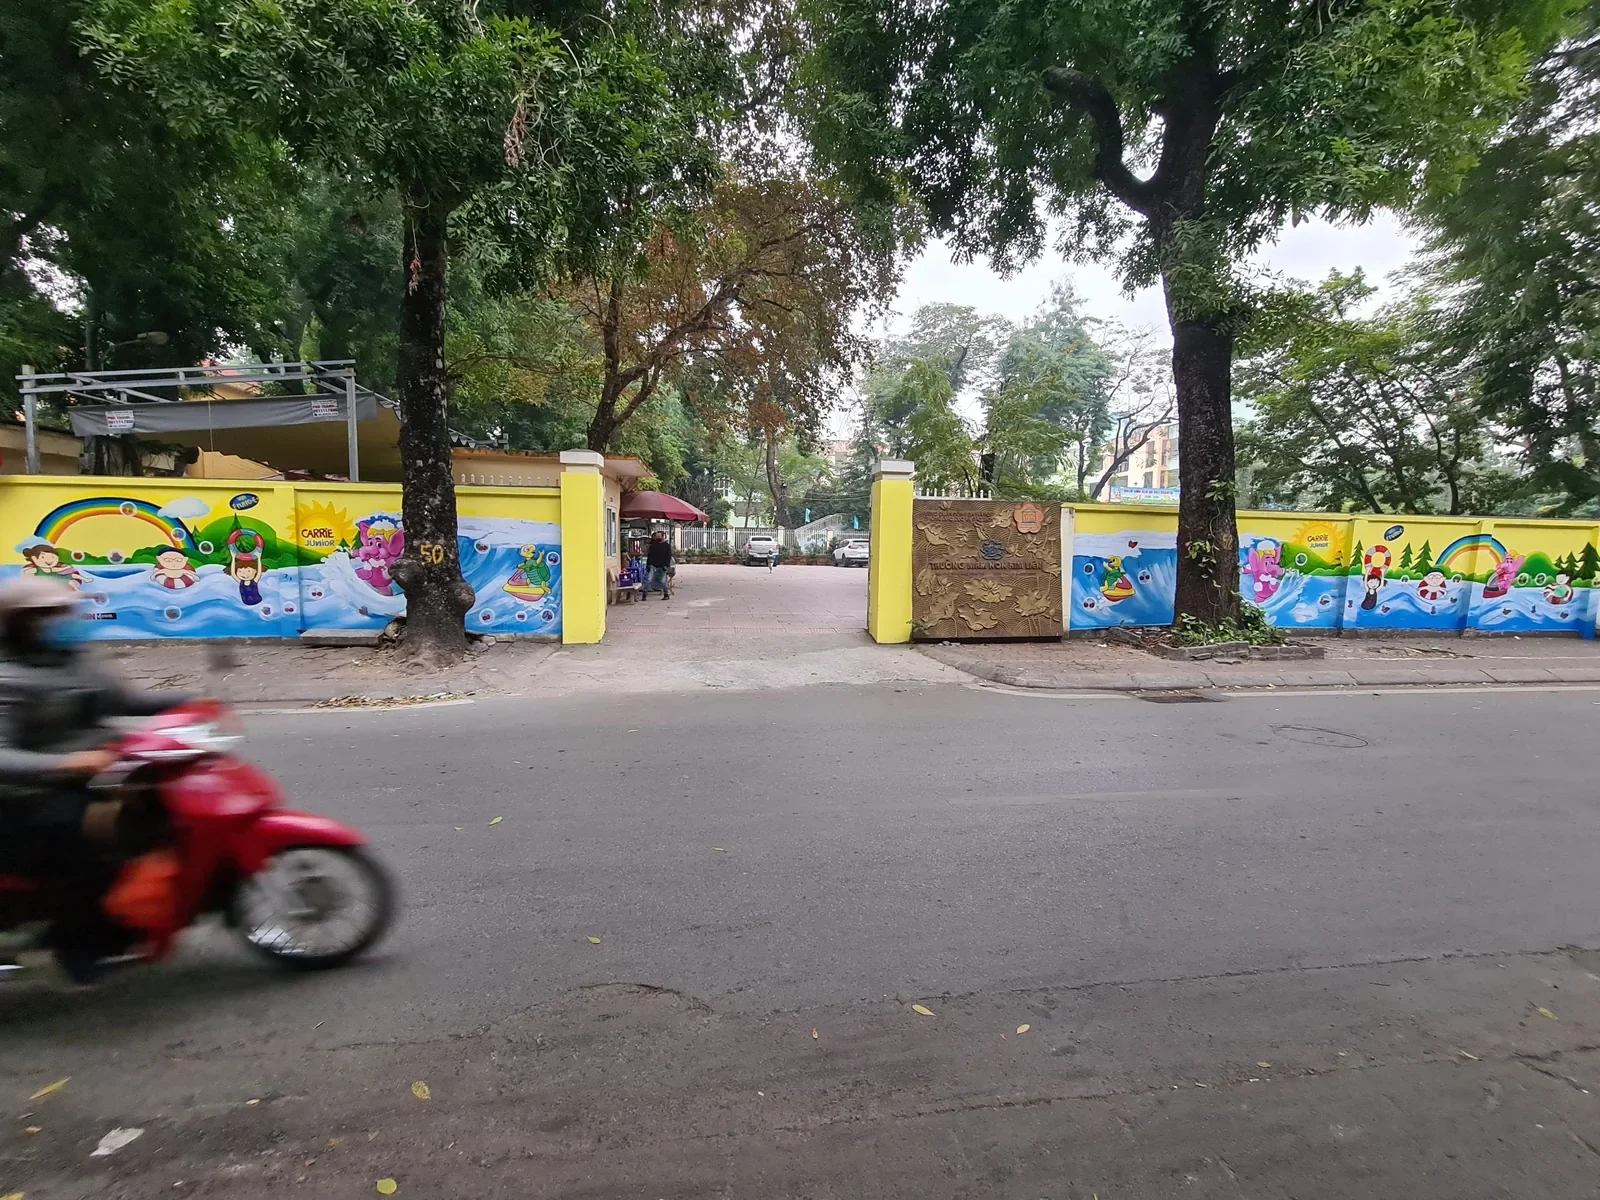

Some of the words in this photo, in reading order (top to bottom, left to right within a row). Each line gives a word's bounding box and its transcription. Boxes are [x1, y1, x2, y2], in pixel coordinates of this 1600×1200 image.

[301, 528, 334, 538] CARRIE
[1307, 534, 1328, 542] CARRIE
[420, 544, 444, 565] 50
[988, 561, 1007, 570] NON
